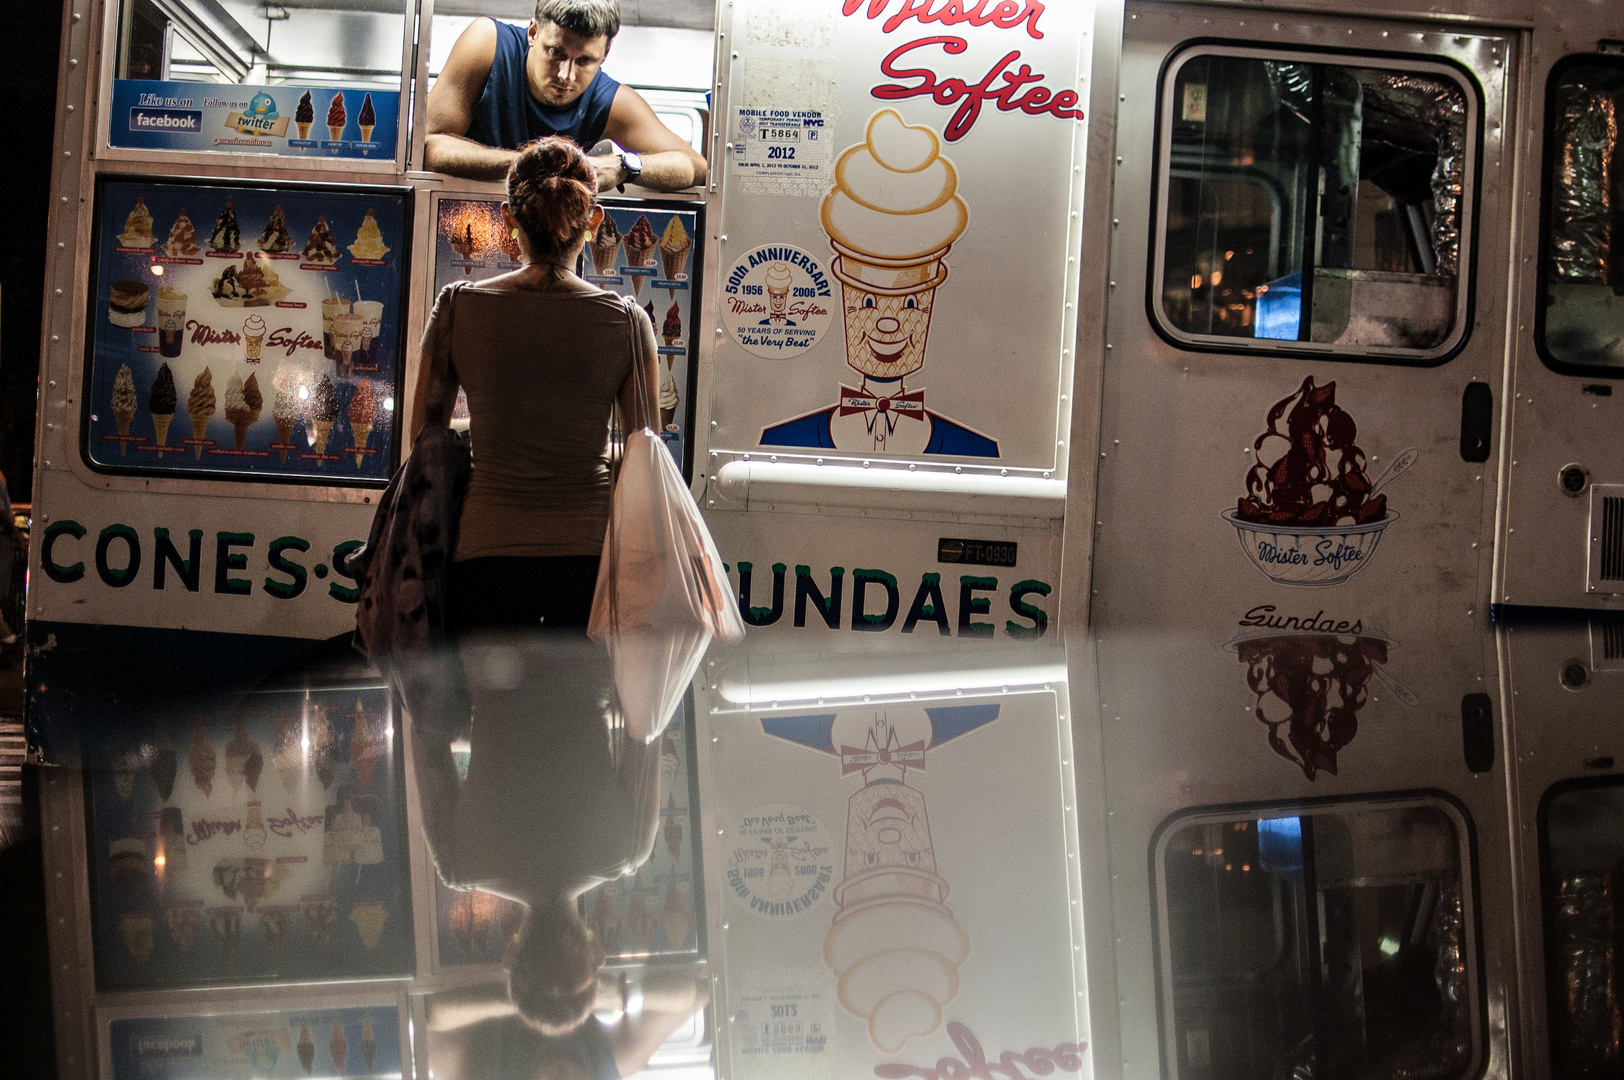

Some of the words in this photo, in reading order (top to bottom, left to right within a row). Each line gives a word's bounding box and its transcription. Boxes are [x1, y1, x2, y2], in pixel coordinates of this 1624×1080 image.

[871, 35, 1084, 143] Softee
[138, 93, 163, 107] Like
[165, 97, 179, 107] us
[180, 97, 193, 107] on
[203, 98, 228, 109] Follow
[229, 100, 238, 109] us
[238, 100, 248, 109] on
[137, 113, 196, 129] facebook
[739, 109, 767, 117] MOBILE
[770, 110, 790, 118] FOOD
[792, 111, 822, 119] VENDOR
[237, 115, 275, 131] twitter
[803, 119, 824, 127] NYC
[768, 146, 796, 159] 2012
[725, 265, 749, 295] 50th
[748, 247, 832, 297] ANNIVERSARY
[741, 285, 763, 295] 1956
[792, 287, 816, 298] 2006
[727, 296, 767, 315] Mister
[787, 301, 828, 322] Softee
[185, 320, 241, 347] Mister
[265, 328, 324, 357] Softee
[747, 327, 772, 335] YEARS
[760, 335, 784, 350] Very
[848, 398, 871, 407] Mister
[966, 544, 1015, 563] FT-0930
[1258, 541, 1309, 565] Mister
[1313, 540, 1363, 570] Softee
[728, 561, 1053, 641] UNDAES
[1238, 605, 1363, 634] Sundaes
